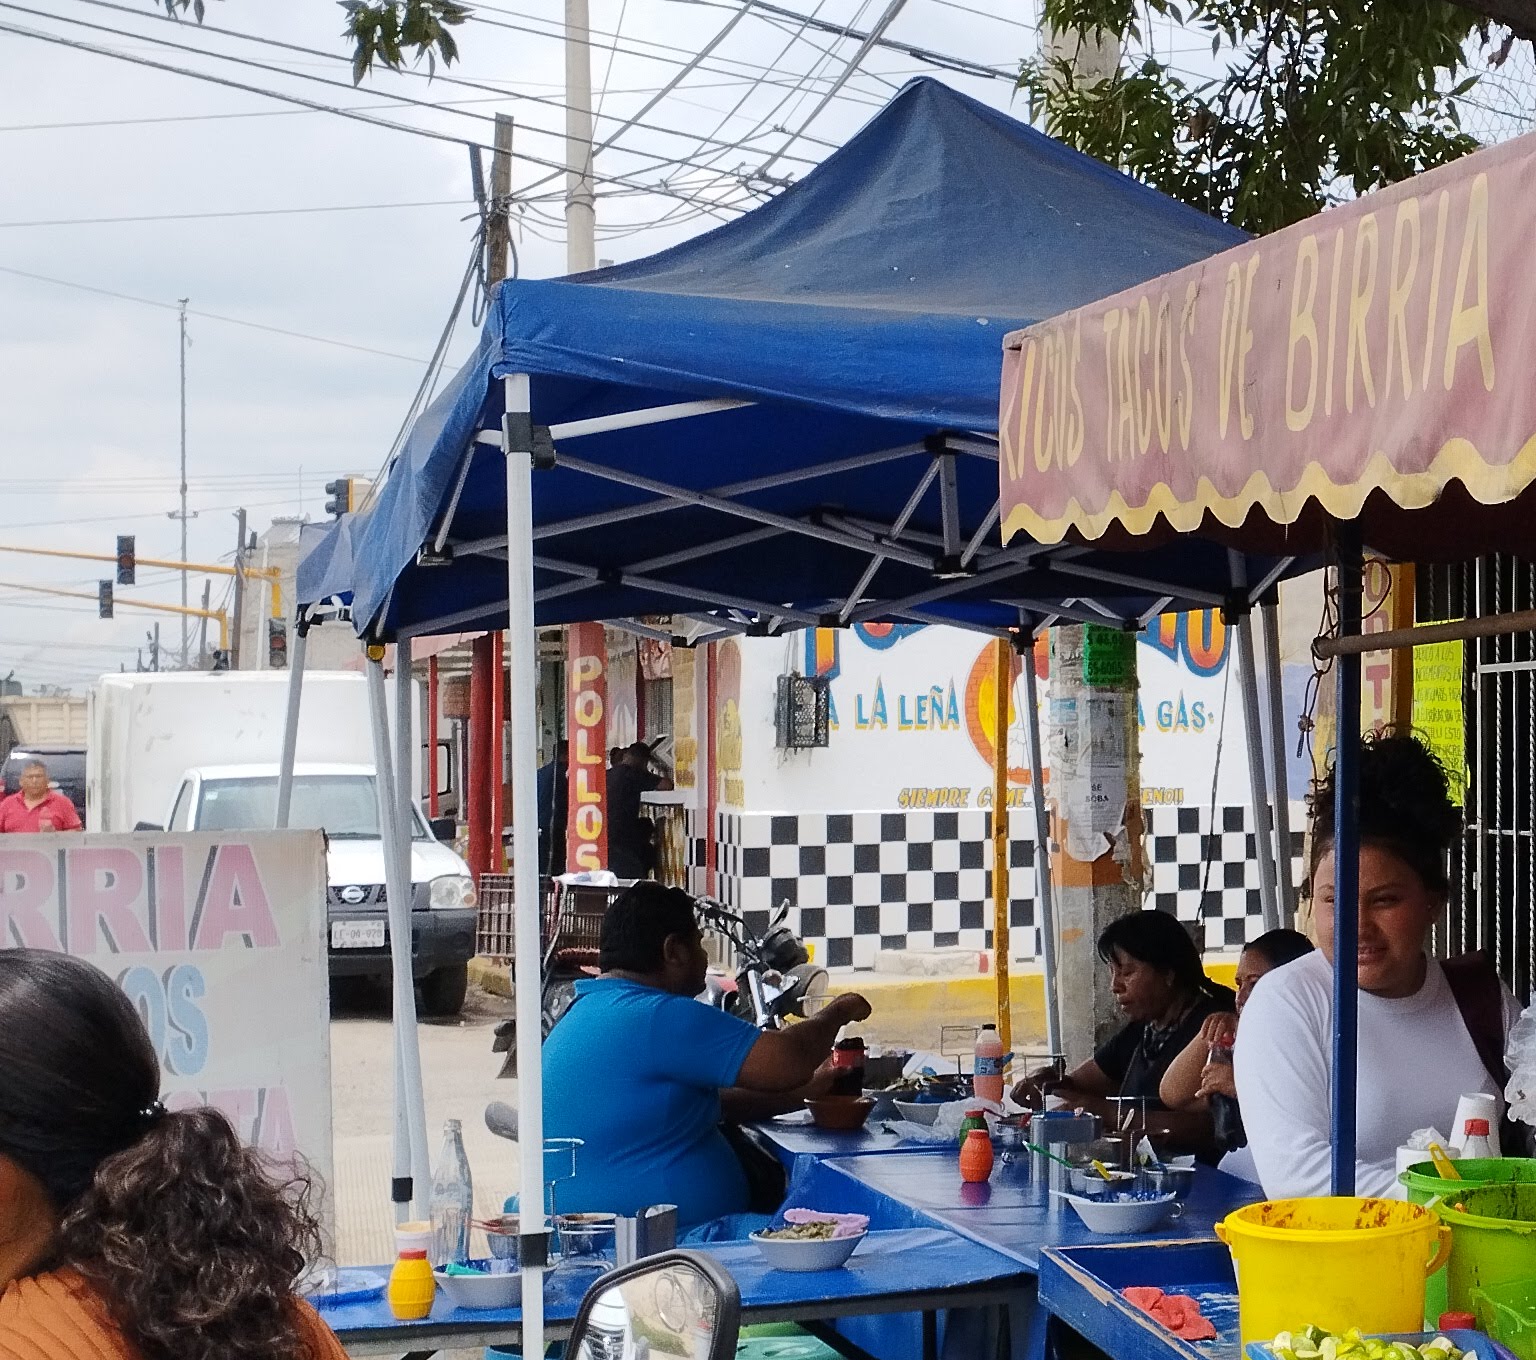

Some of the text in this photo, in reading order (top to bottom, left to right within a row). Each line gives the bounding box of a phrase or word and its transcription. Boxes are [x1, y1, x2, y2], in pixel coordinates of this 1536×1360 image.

[1103, 280, 1196, 462] TACOS
[1216, 253, 1259, 441] DE
[1285, 171, 1495, 433] BIRRIA
[572, 654, 604, 871] POLLOS
[854, 675, 889, 731] LA
[897, 675, 960, 731] LEÑA
[898, 787, 970, 808] SIEMPRE
